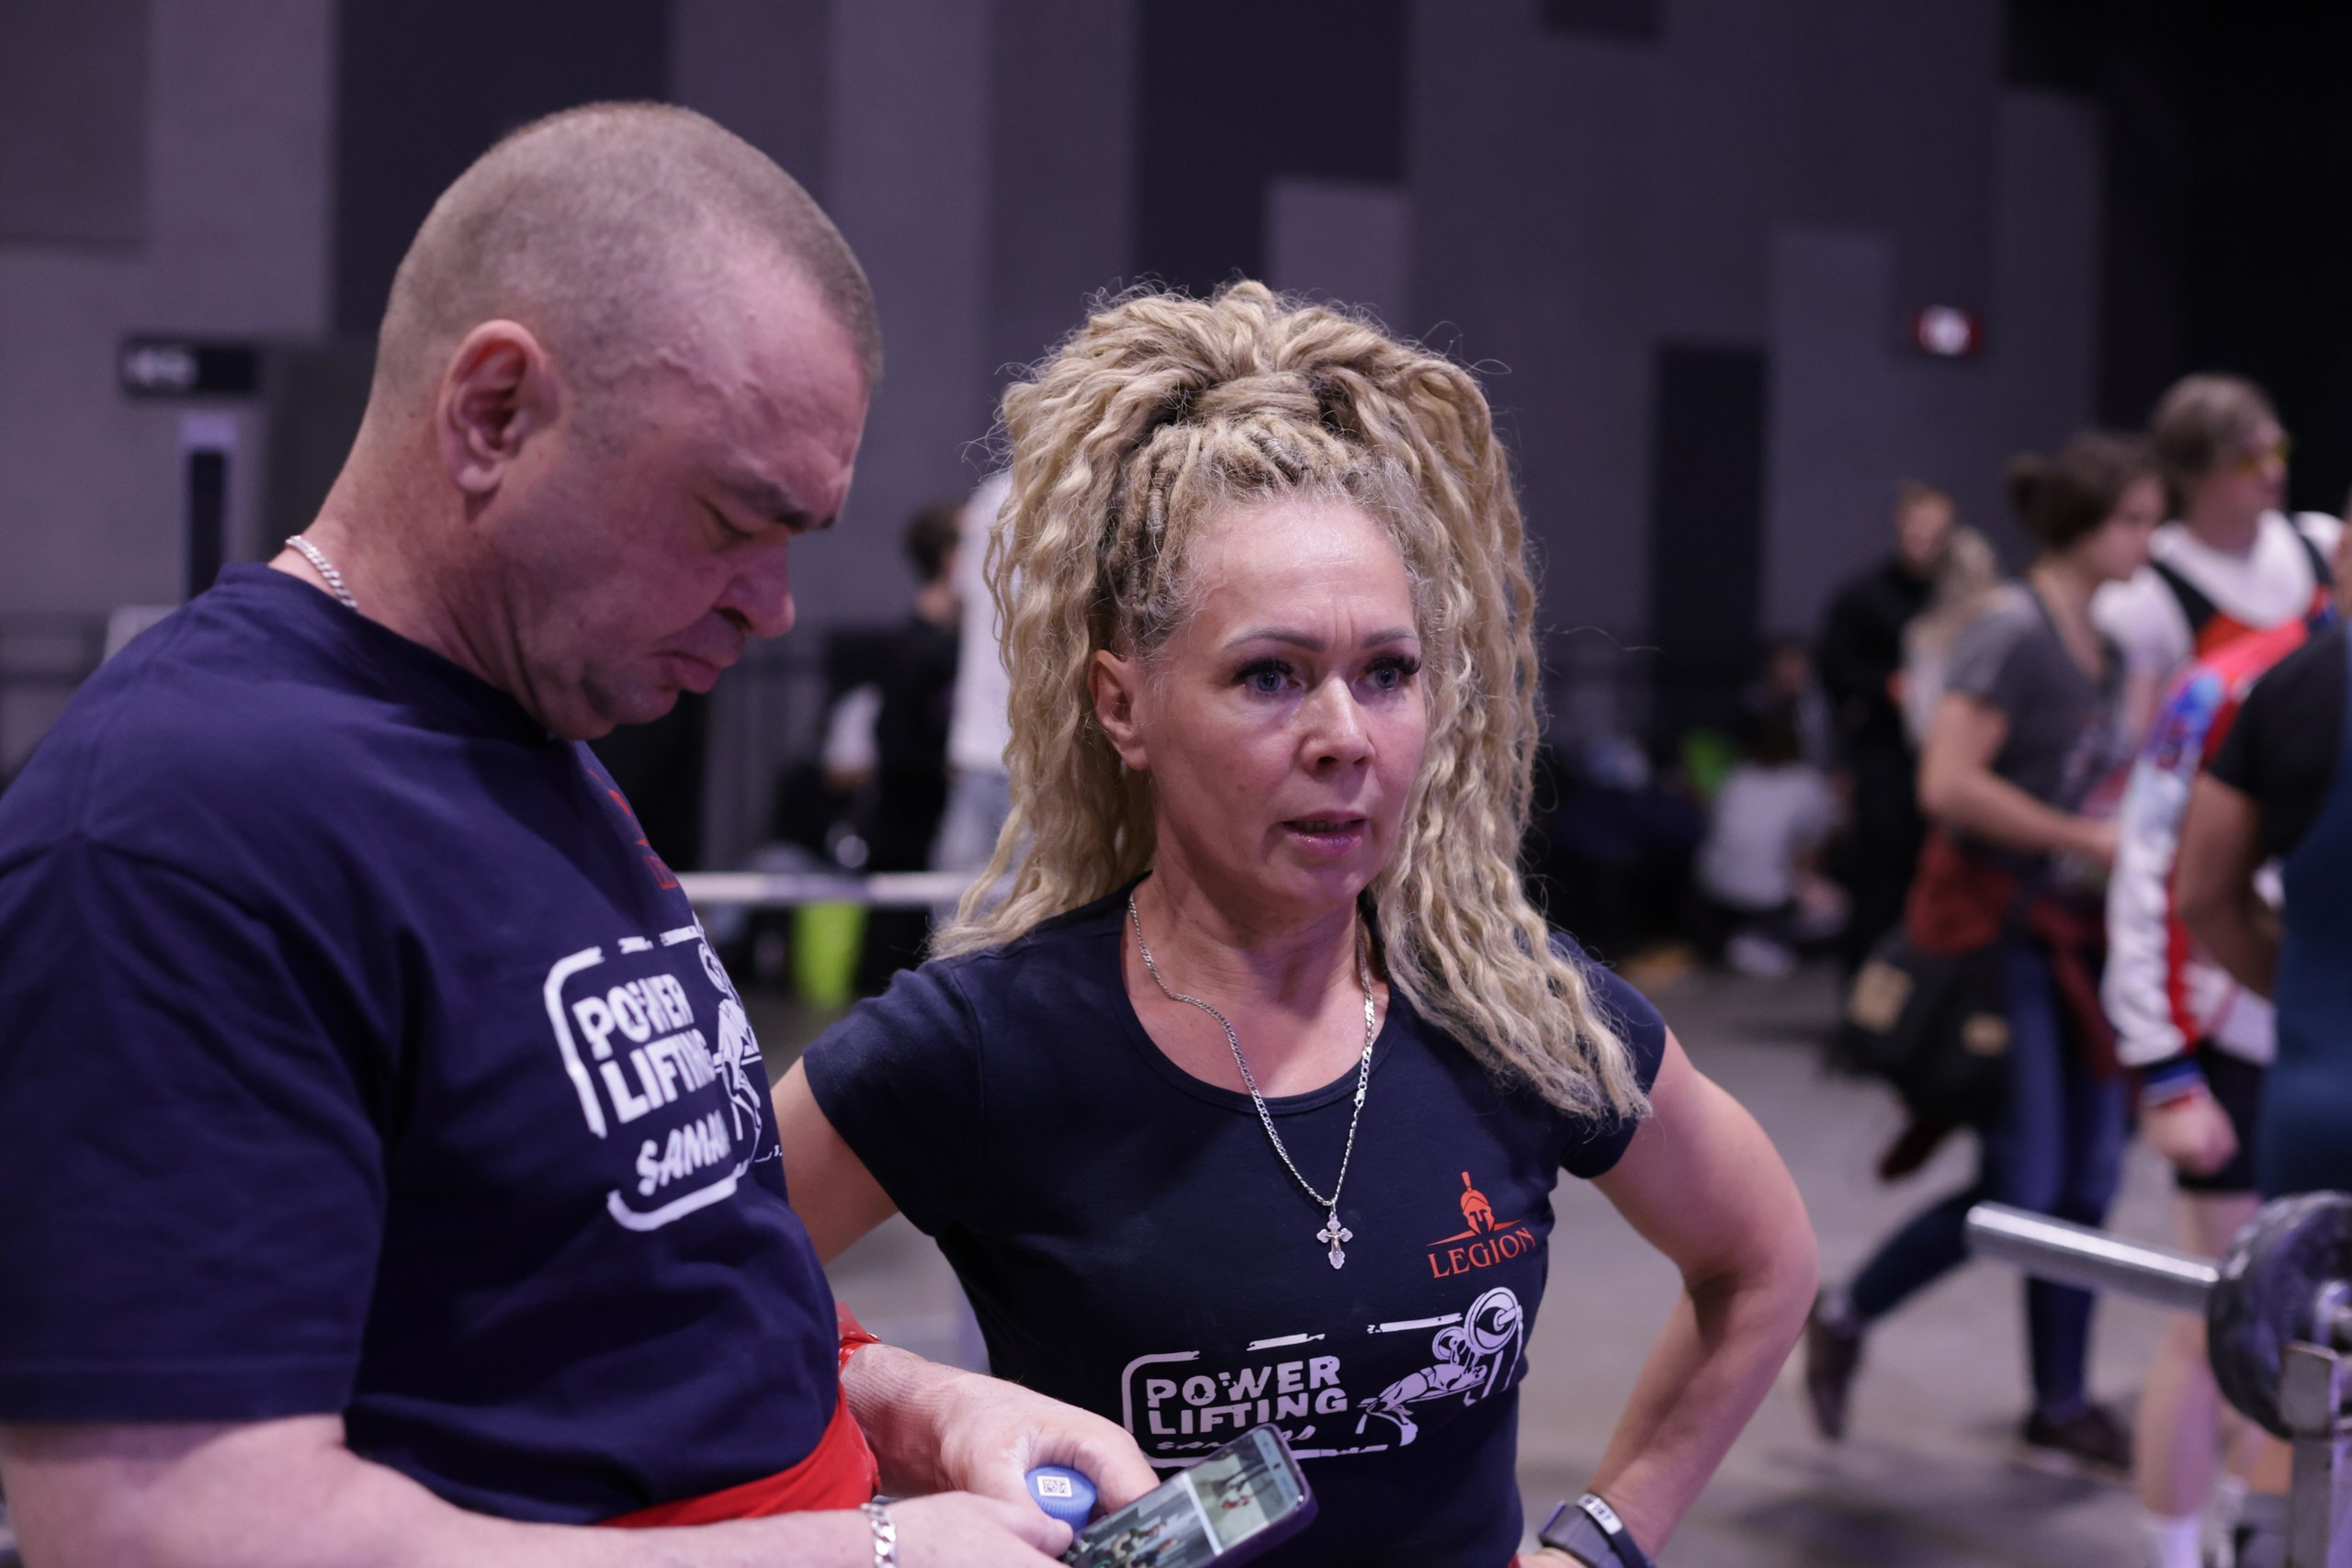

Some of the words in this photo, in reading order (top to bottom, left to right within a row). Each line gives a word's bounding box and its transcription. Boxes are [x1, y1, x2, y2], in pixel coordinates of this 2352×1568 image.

[572, 974, 695, 1060] POWER
[1428, 1227, 1537, 1278] LEGION
[1147, 1356, 1340, 1408] POWER
[1148, 1387, 1348, 1434] LIFTING
